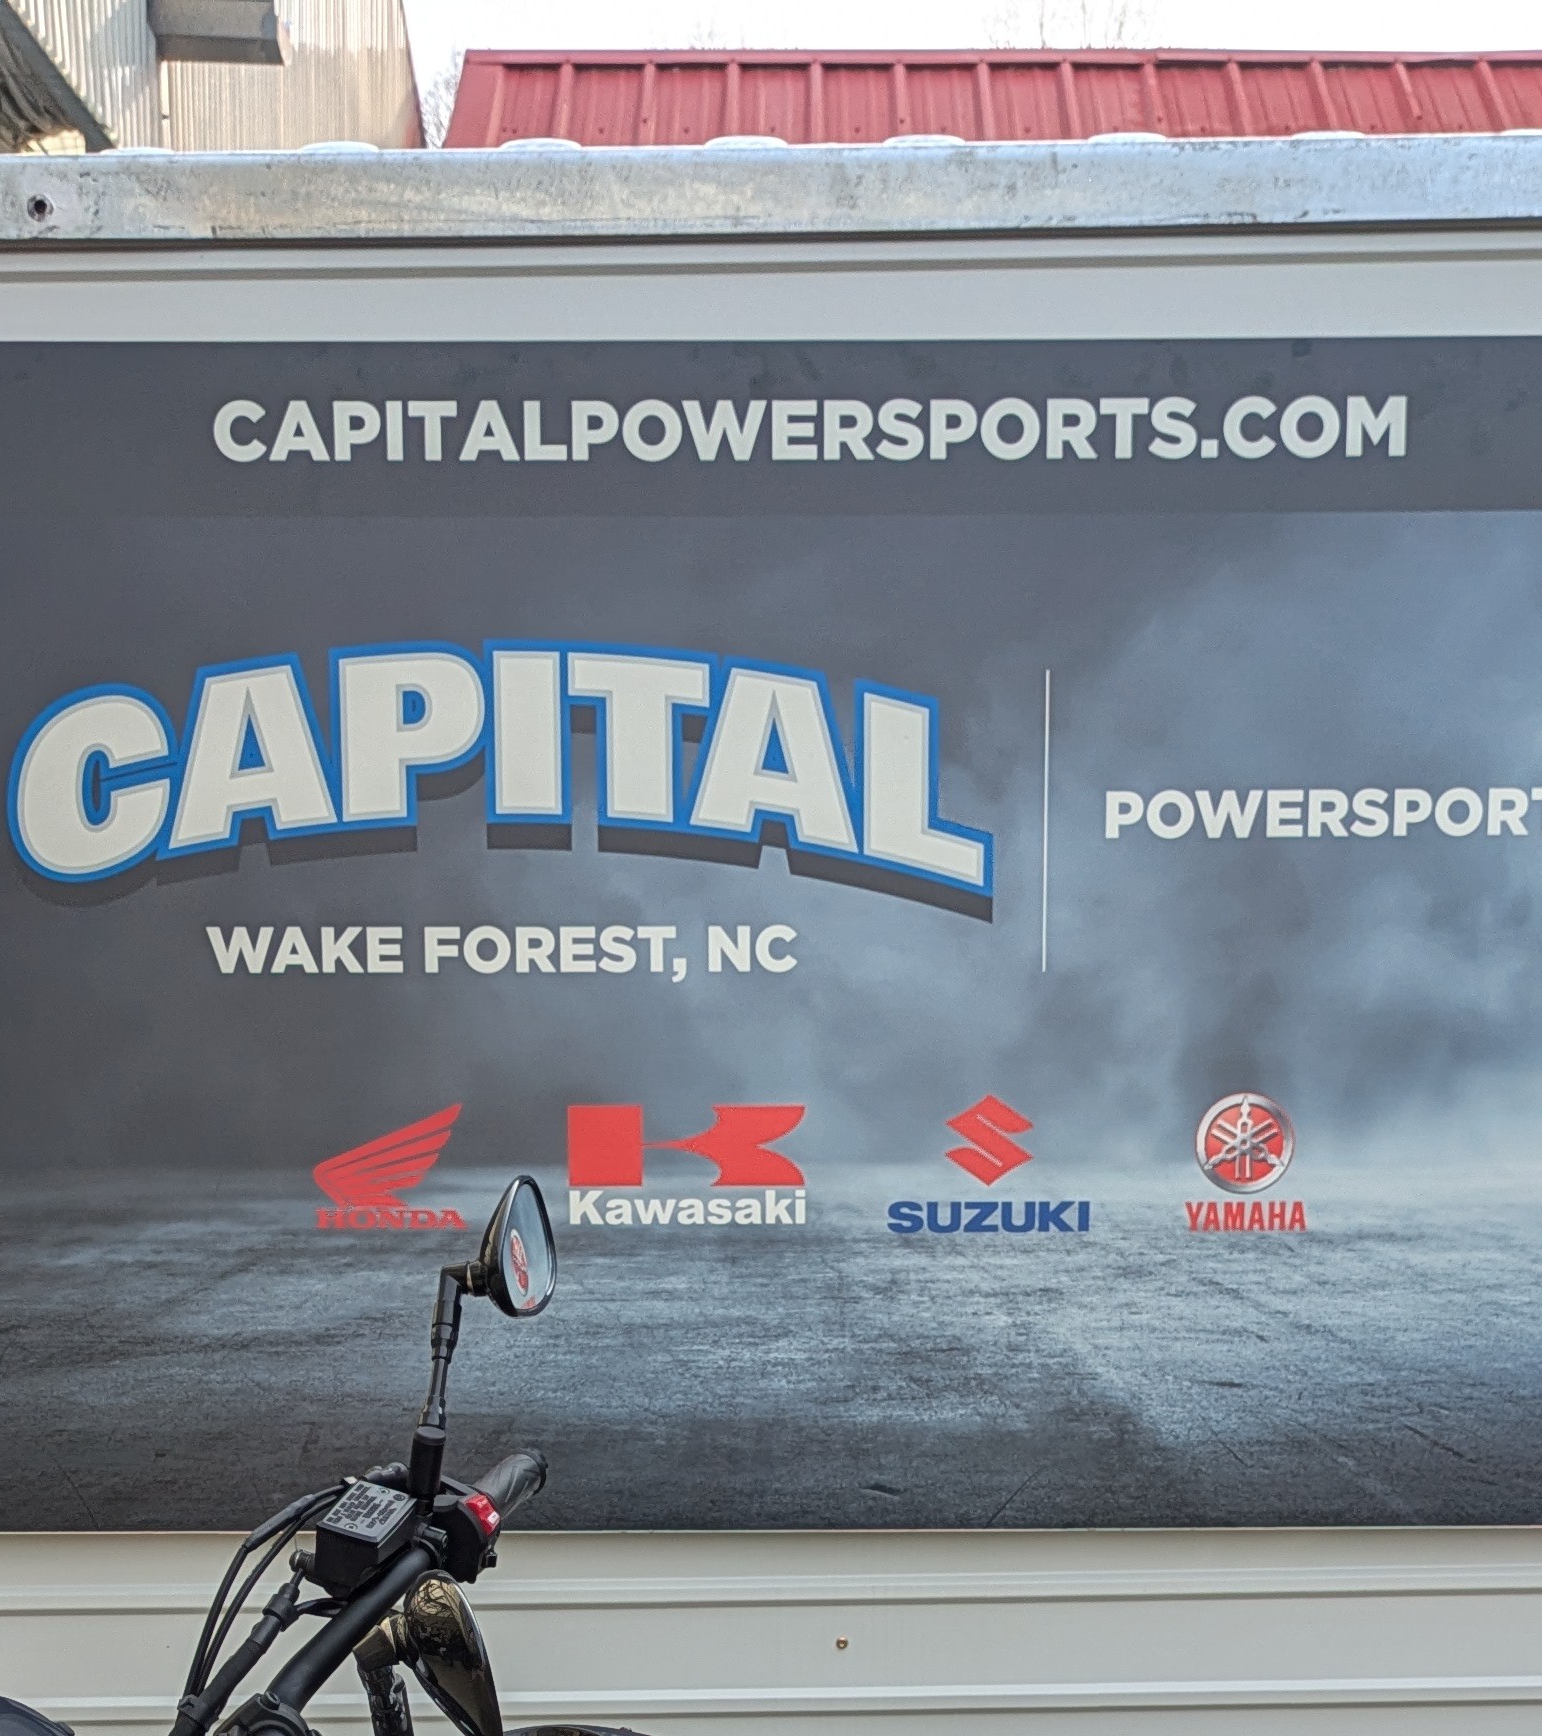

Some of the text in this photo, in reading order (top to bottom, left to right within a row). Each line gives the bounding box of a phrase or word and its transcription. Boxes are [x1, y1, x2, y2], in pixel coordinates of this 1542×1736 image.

[213, 395, 1408, 463] CAPITALPOWERSPORTS.COM
[12, 642, 992, 895] CAPITAL
[205, 924, 799, 983] WAKE FOREST, NC
[314, 1207, 467, 1230] HONDA
[568, 1187, 807, 1226] Kawasaki
[888, 1200, 1091, 1234] SUZUKI
[1185, 1200, 1308, 1232] YAMAHA
